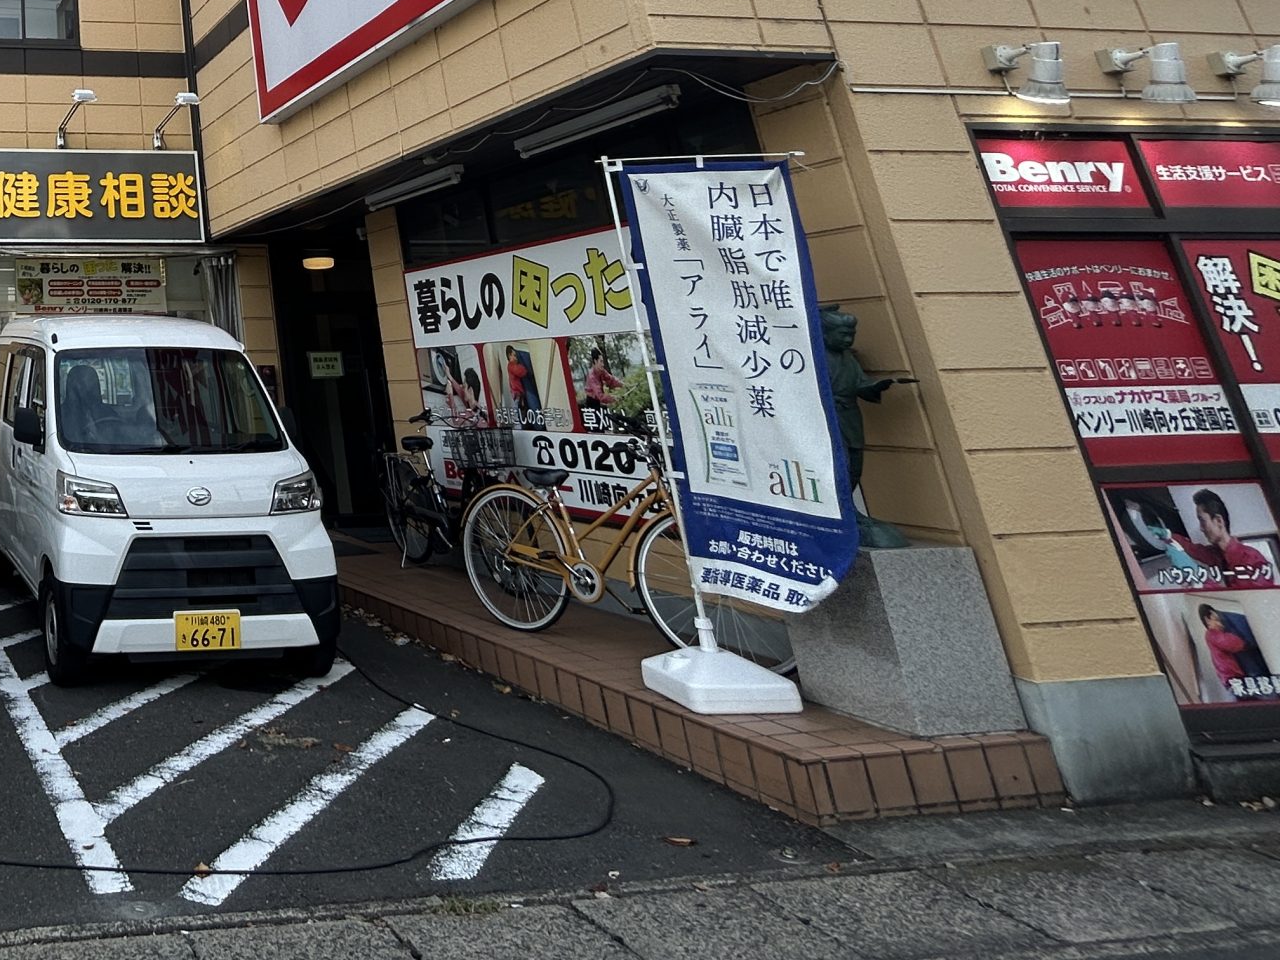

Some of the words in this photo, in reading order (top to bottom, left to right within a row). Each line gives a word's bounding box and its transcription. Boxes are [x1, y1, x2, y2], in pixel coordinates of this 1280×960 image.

[980, 152, 1124, 192] Benry
[1156, 165, 1271, 182] 生活支援サービス
[992, 183, 1018, 192] TOTAL
[1019, 184, 1075, 193] CONVENIENCE
[1076, 184, 1108, 193] SERVICE
[39, 262, 80, 274] 暮らしの
[748, 183, 805, 374] 日本で唯一の
[707, 182, 775, 419] 内臓脂肪減少薬
[737, 530, 799, 556] 販売時間は
[708, 539, 833, 580] お問い合わせください
[1158, 564, 1274, 585] ハウスクリーニング
[190, 627, 235, 647] 66-71
